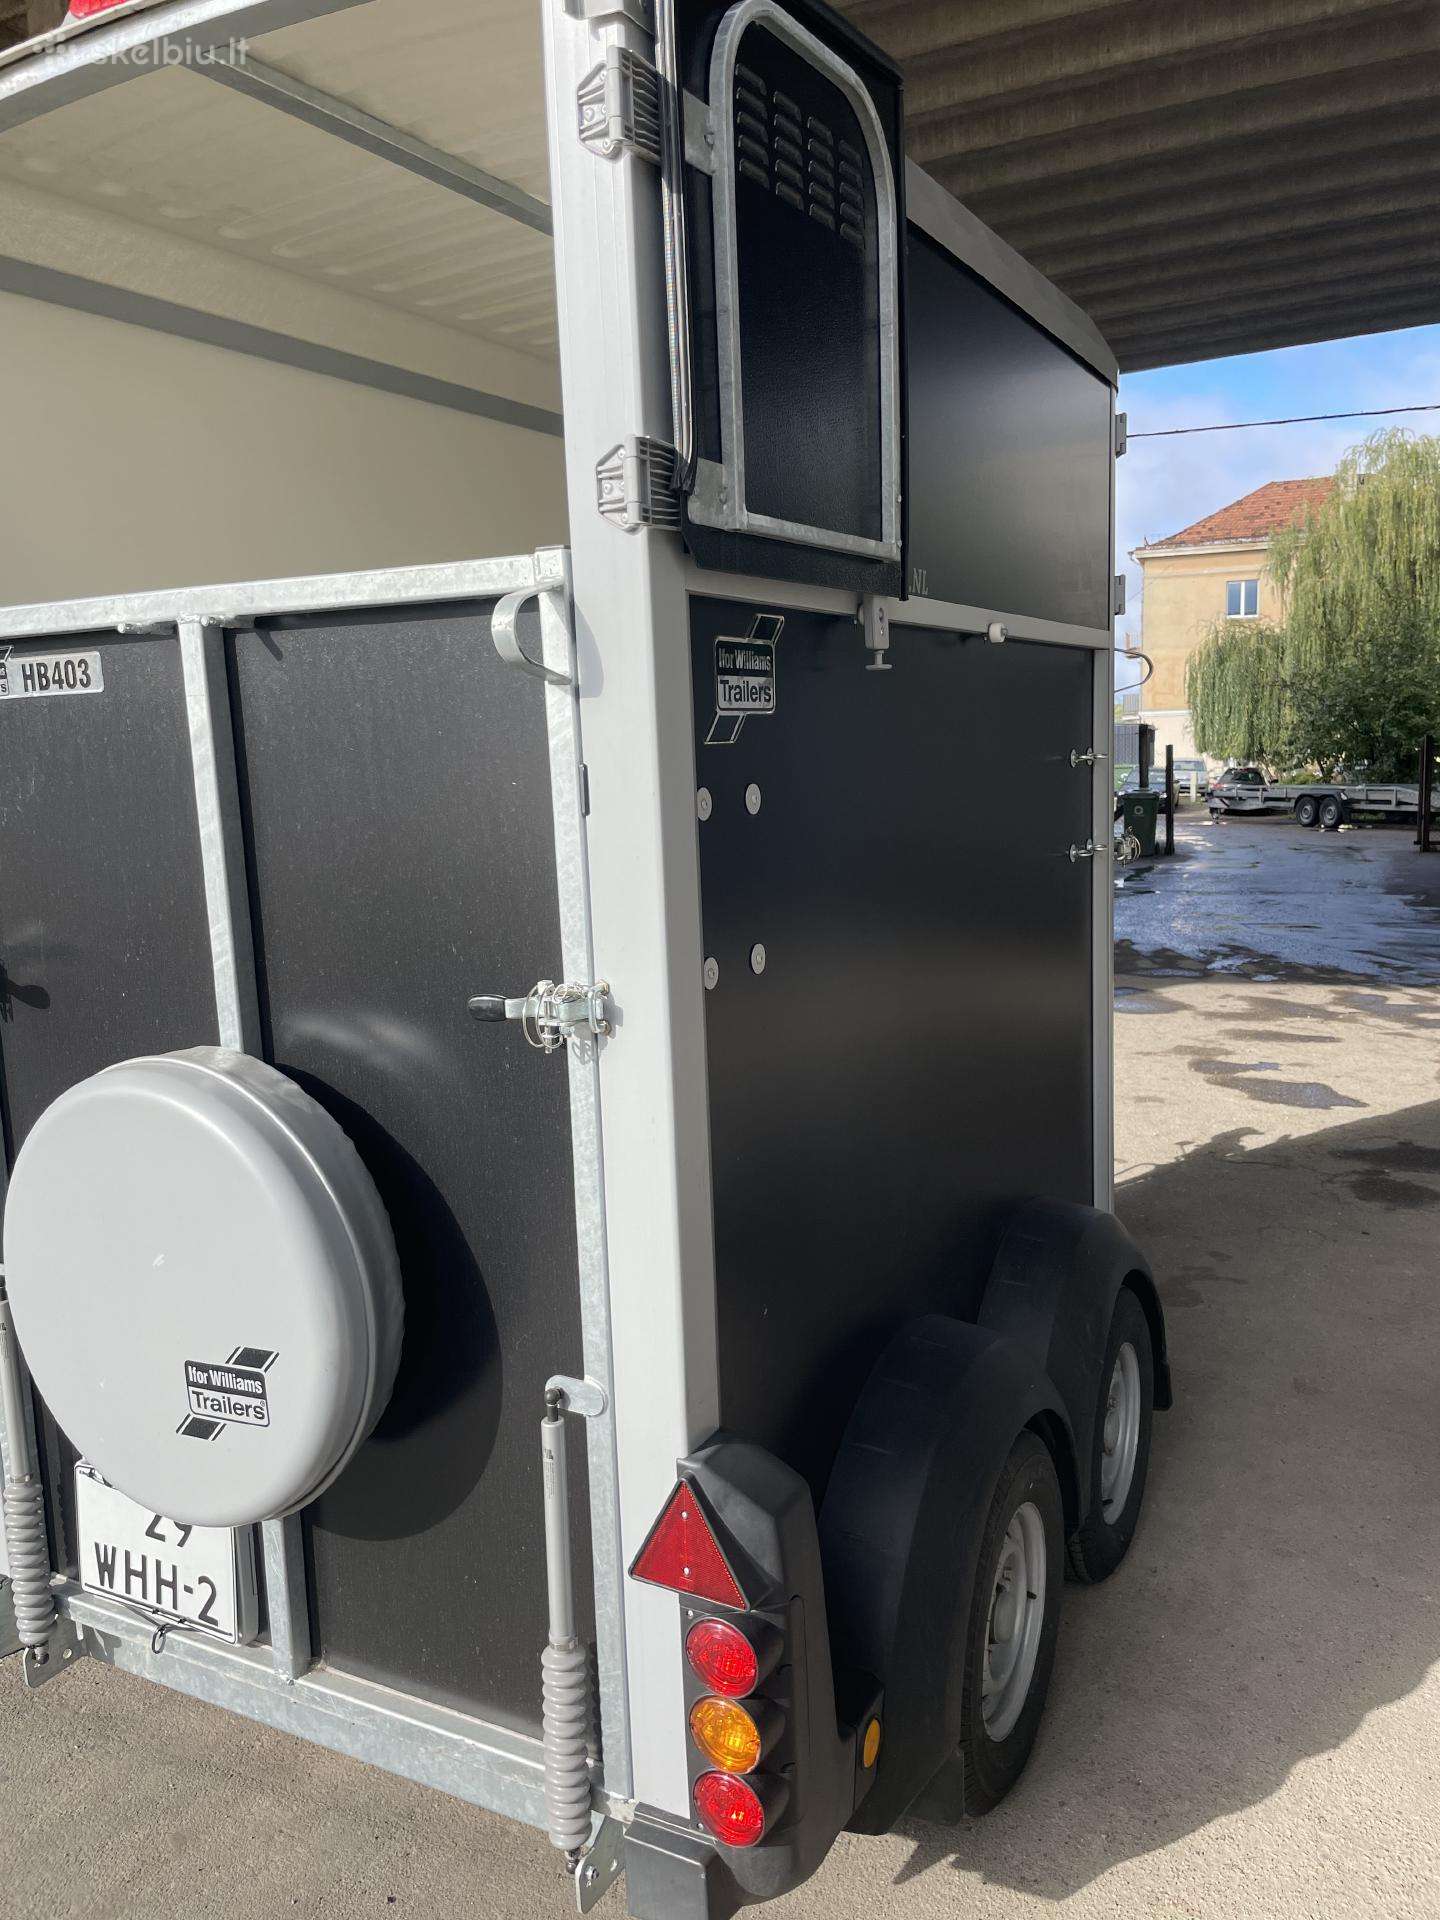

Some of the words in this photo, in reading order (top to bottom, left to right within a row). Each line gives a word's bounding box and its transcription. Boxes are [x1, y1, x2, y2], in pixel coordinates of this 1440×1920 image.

[735, 650, 771, 671] Williams
[22, 659, 91, 692] HB403
[720, 679, 771, 703] Trailers
[188, 1365, 208, 1385] Ifor
[209, 1370, 263, 1394] Williams
[94, 1541, 219, 1627] WHH-2
